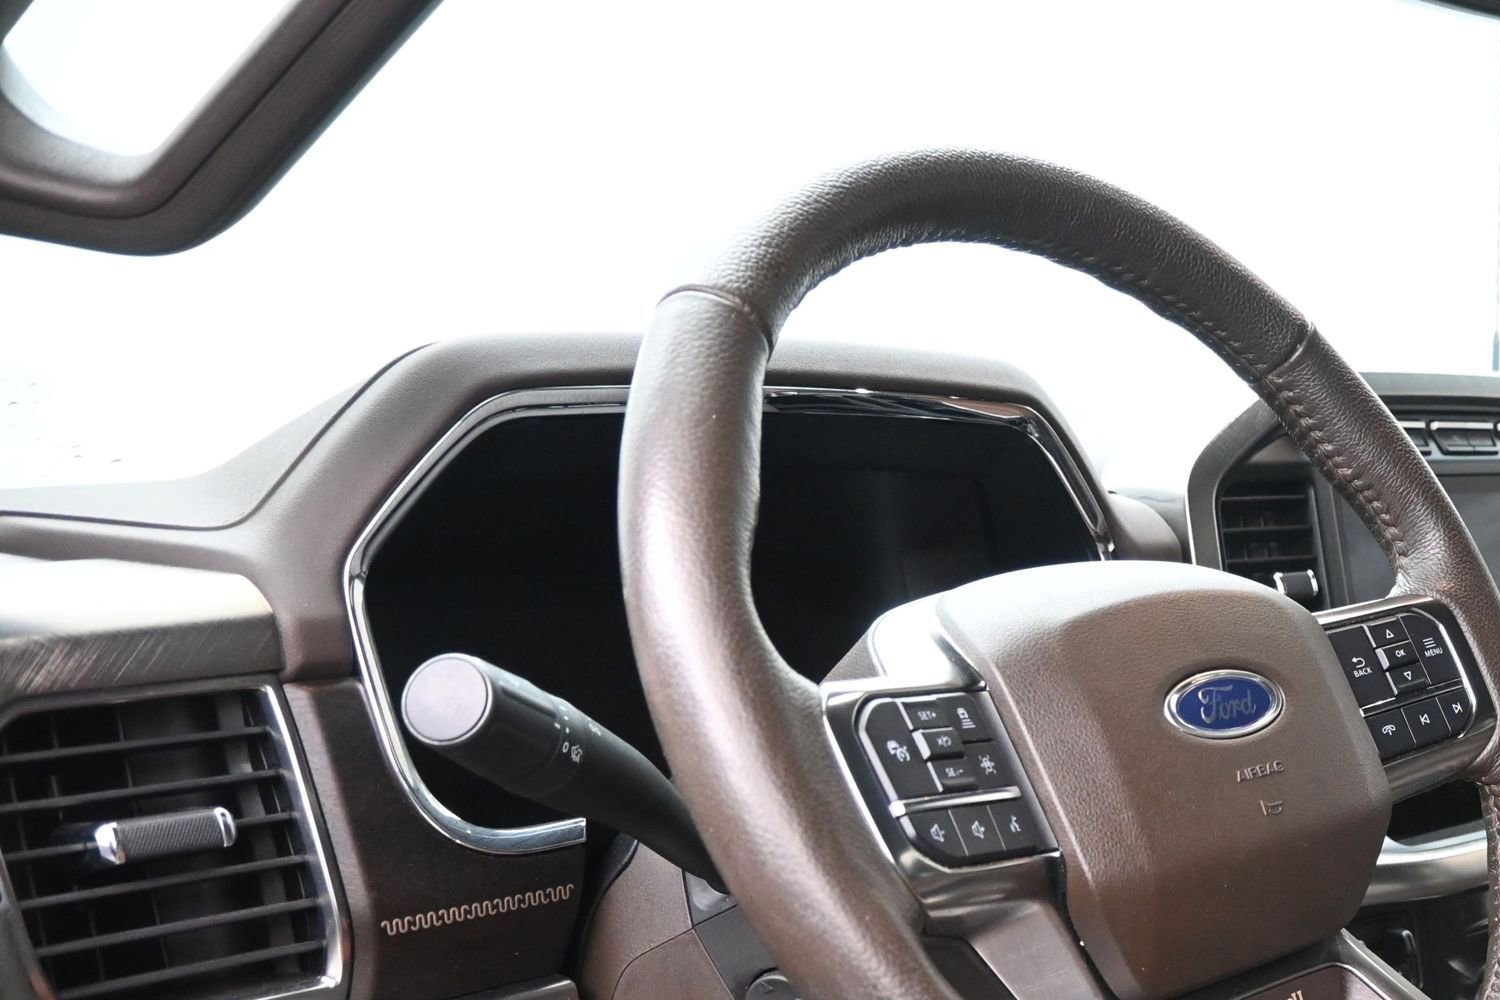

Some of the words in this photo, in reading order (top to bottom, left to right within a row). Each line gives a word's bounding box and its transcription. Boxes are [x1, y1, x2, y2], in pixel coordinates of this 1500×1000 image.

[1395, 649, 1406, 658] OK
[1424, 647, 1443, 657] MENU
[1353, 667, 1372, 678] BACK
[1198, 684, 1257, 724] Ford
